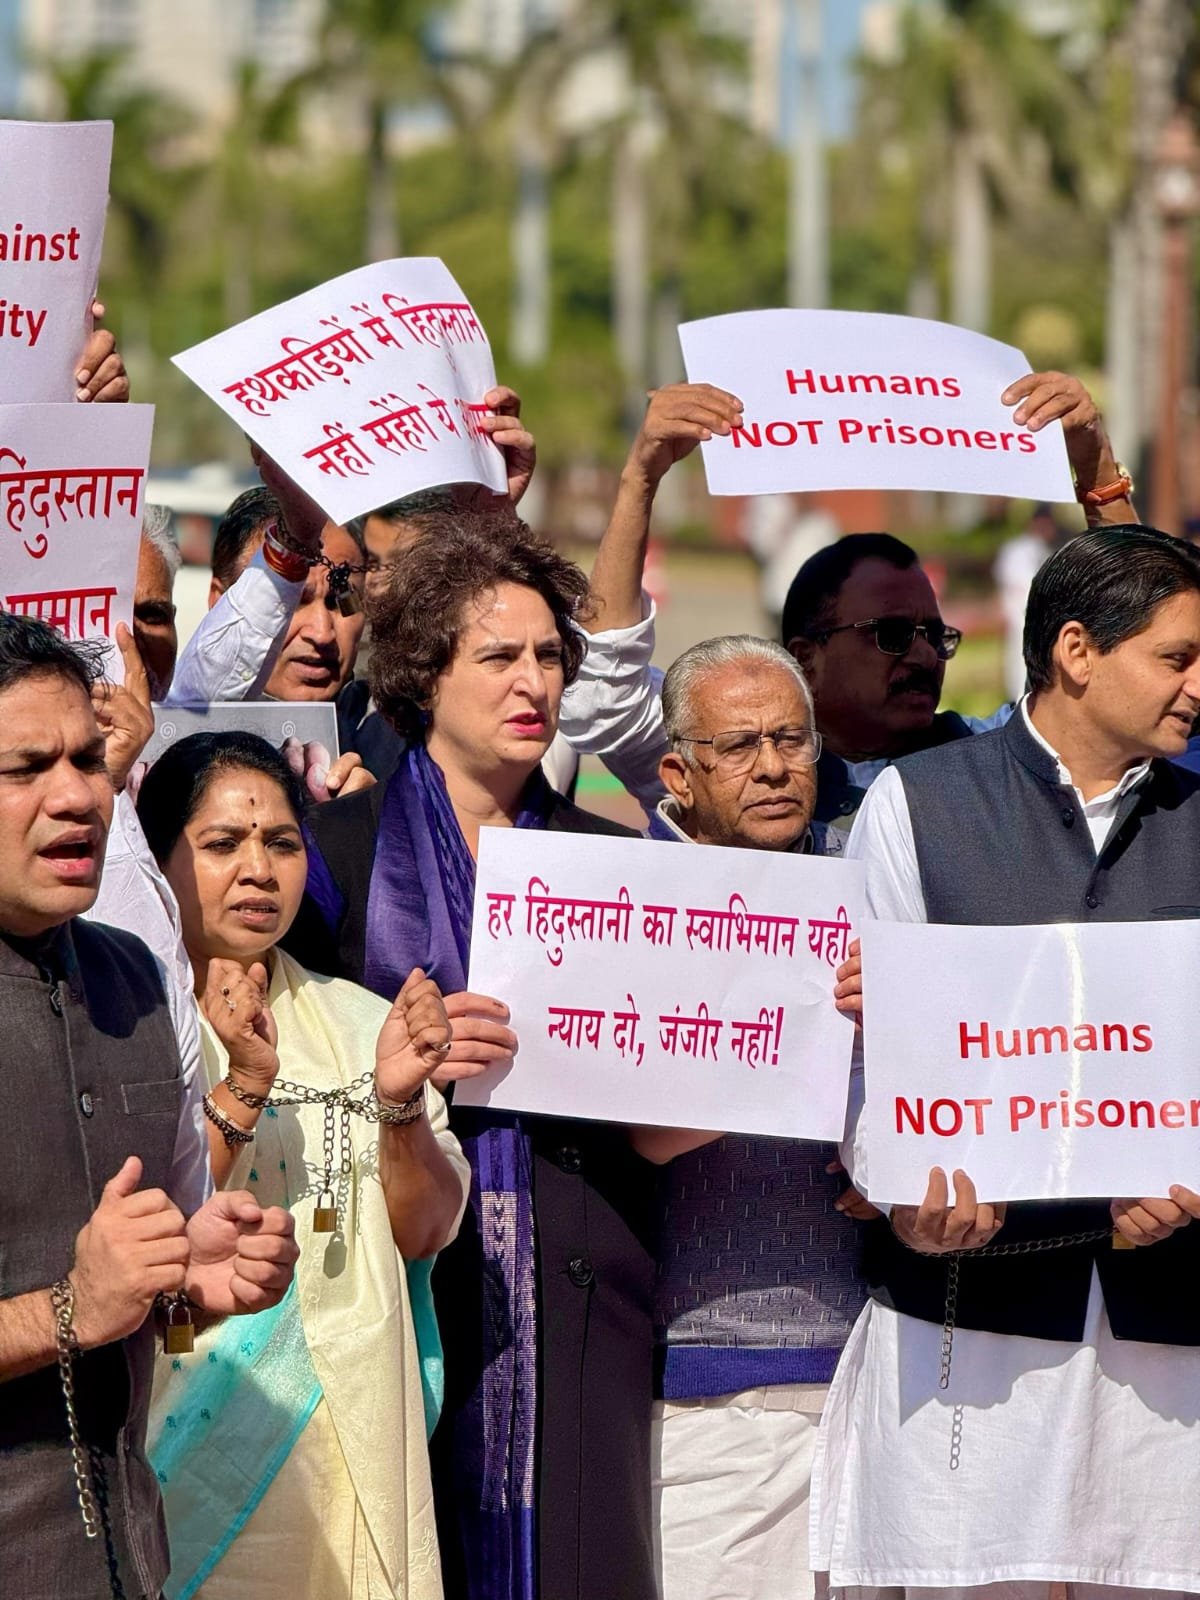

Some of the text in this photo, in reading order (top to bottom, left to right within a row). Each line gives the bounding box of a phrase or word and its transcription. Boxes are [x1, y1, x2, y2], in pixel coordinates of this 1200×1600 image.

[222, 315, 375, 416] हथकड़ियों
[350, 302, 404, 349] में
[785, 369, 962, 399] Humans
[302, 421, 376, 478] नहीं
[417, 383, 462, 440] ये
[730, 419, 1037, 454] NOT Prisoners
[486, 876, 852, 968] हर हिंदुस्तानी का स्वाभिमान यही
[547, 993, 785, 1069] न्याय दो, जंजीर नहीं!
[959, 1021, 1153, 1059] Humans
[894, 1096, 993, 1137] NOT
